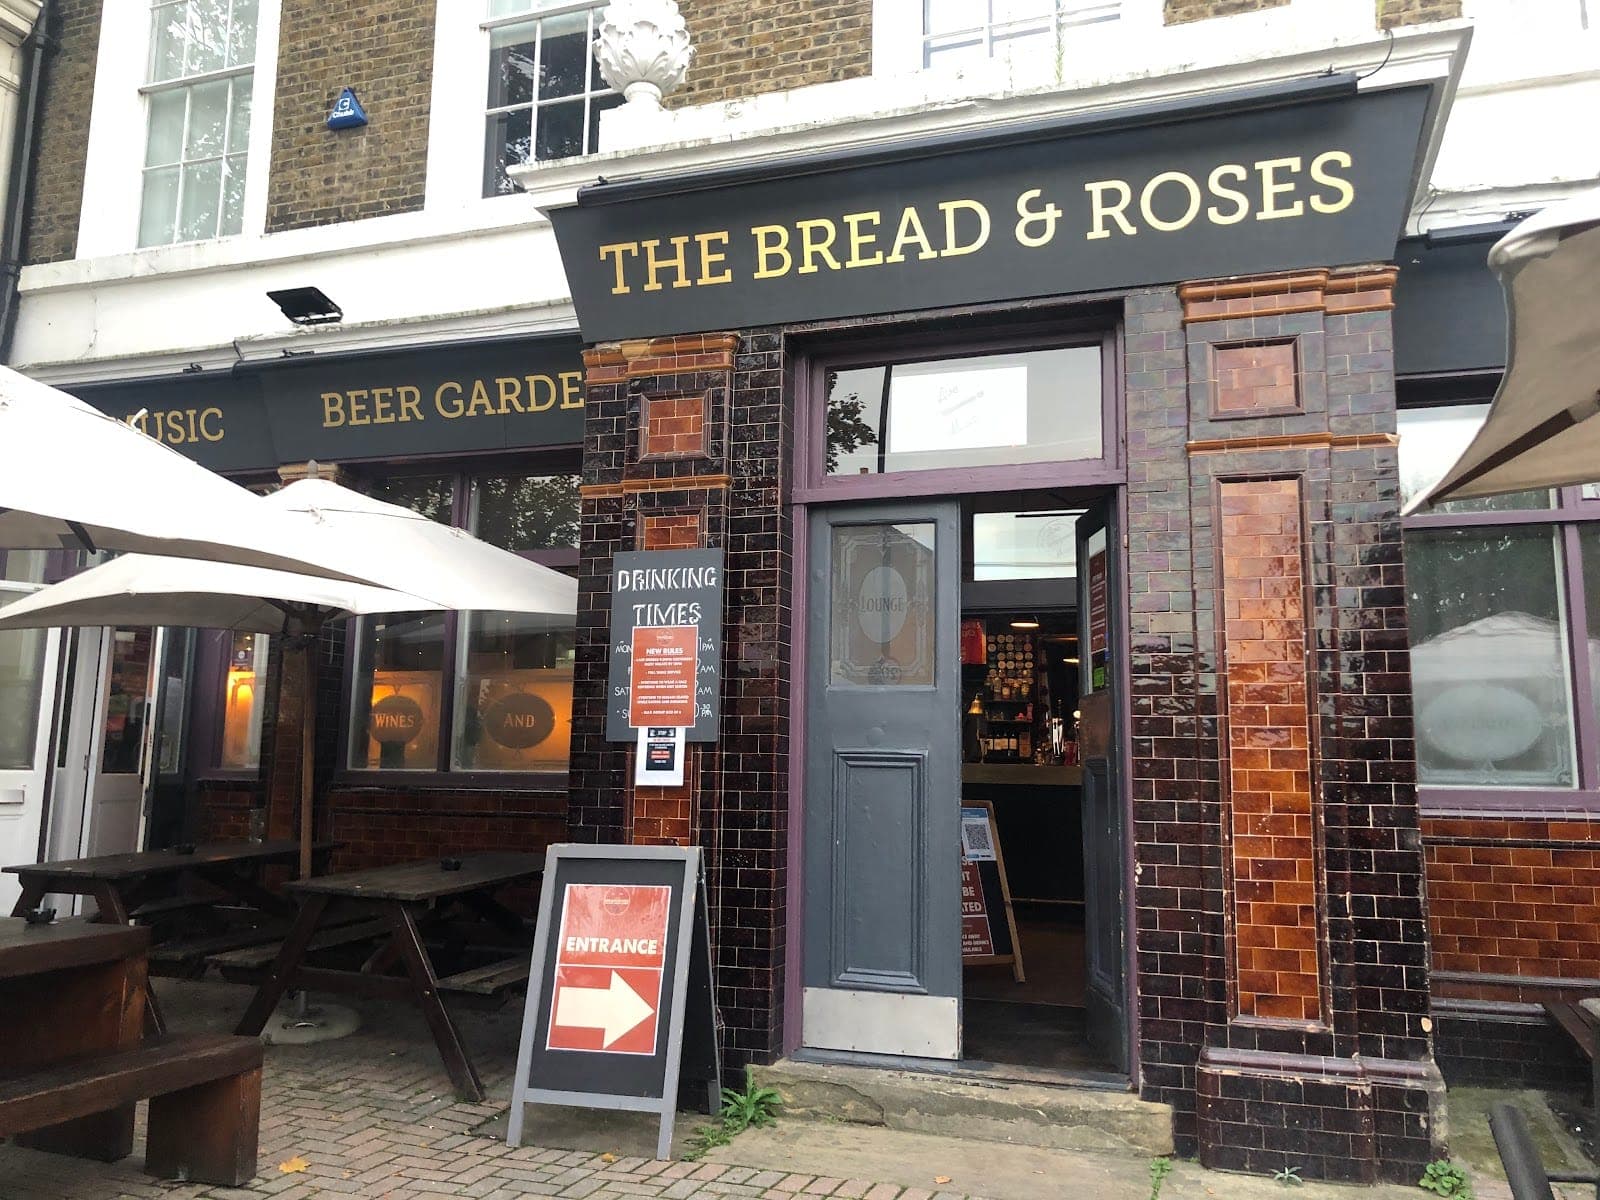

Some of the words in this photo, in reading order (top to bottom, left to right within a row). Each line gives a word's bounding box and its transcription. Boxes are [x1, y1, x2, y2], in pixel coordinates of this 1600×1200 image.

[599, 231, 733, 294] THE
[751, 199, 991, 281] BREAD
[1015, 189, 1062, 248] &
[1084, 150, 1355, 240] ROSES
[320, 386, 426, 428] BEER
[434, 371, 585, 419] GARDE
[126, 407, 225, 444] USIC
[617, 567, 717, 592] DRINKING
[633, 602, 702, 626] TIMES
[859, 597, 904, 613] LOUNGE
[375, 713, 415, 728] WINES
[503, 713, 536, 728] AND
[962, 886, 975, 896] BE
[565, 936, 658, 955] ENTRANCE
